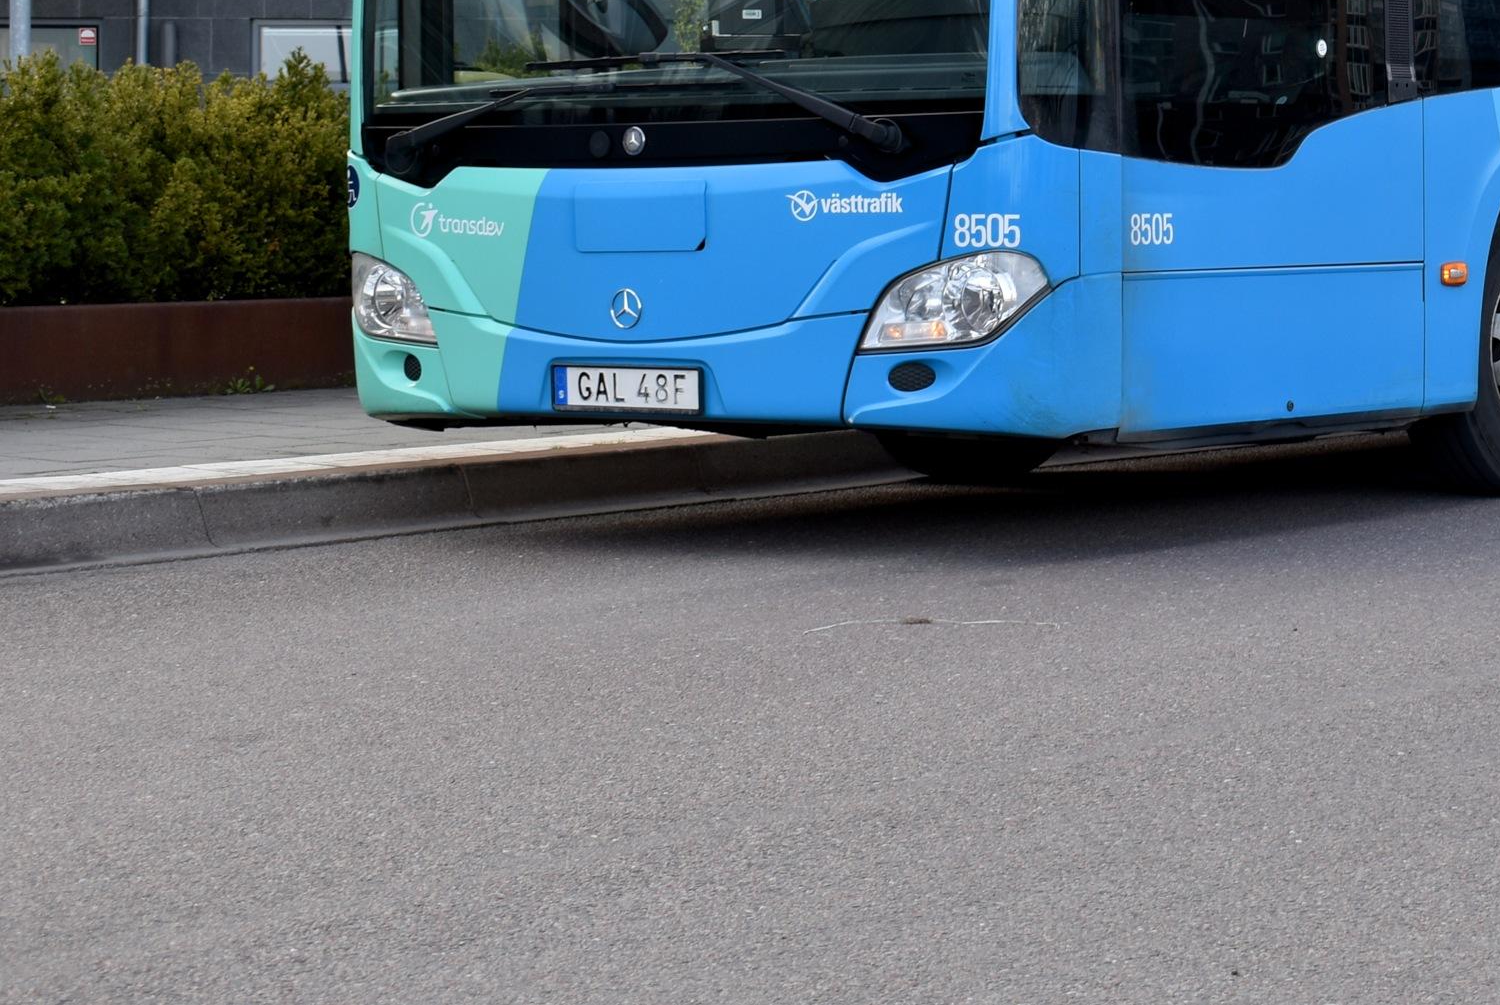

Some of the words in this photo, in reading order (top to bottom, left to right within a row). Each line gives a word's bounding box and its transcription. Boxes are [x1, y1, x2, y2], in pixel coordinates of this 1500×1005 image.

[820, 192, 903, 214] västtrafik
[438, 214, 504, 237] transdev
[954, 213, 1021, 248] 8505
[1130, 213, 1174, 246] 8505
[578, 371, 625, 403] GAL
[637, 373, 686, 405] 48F
